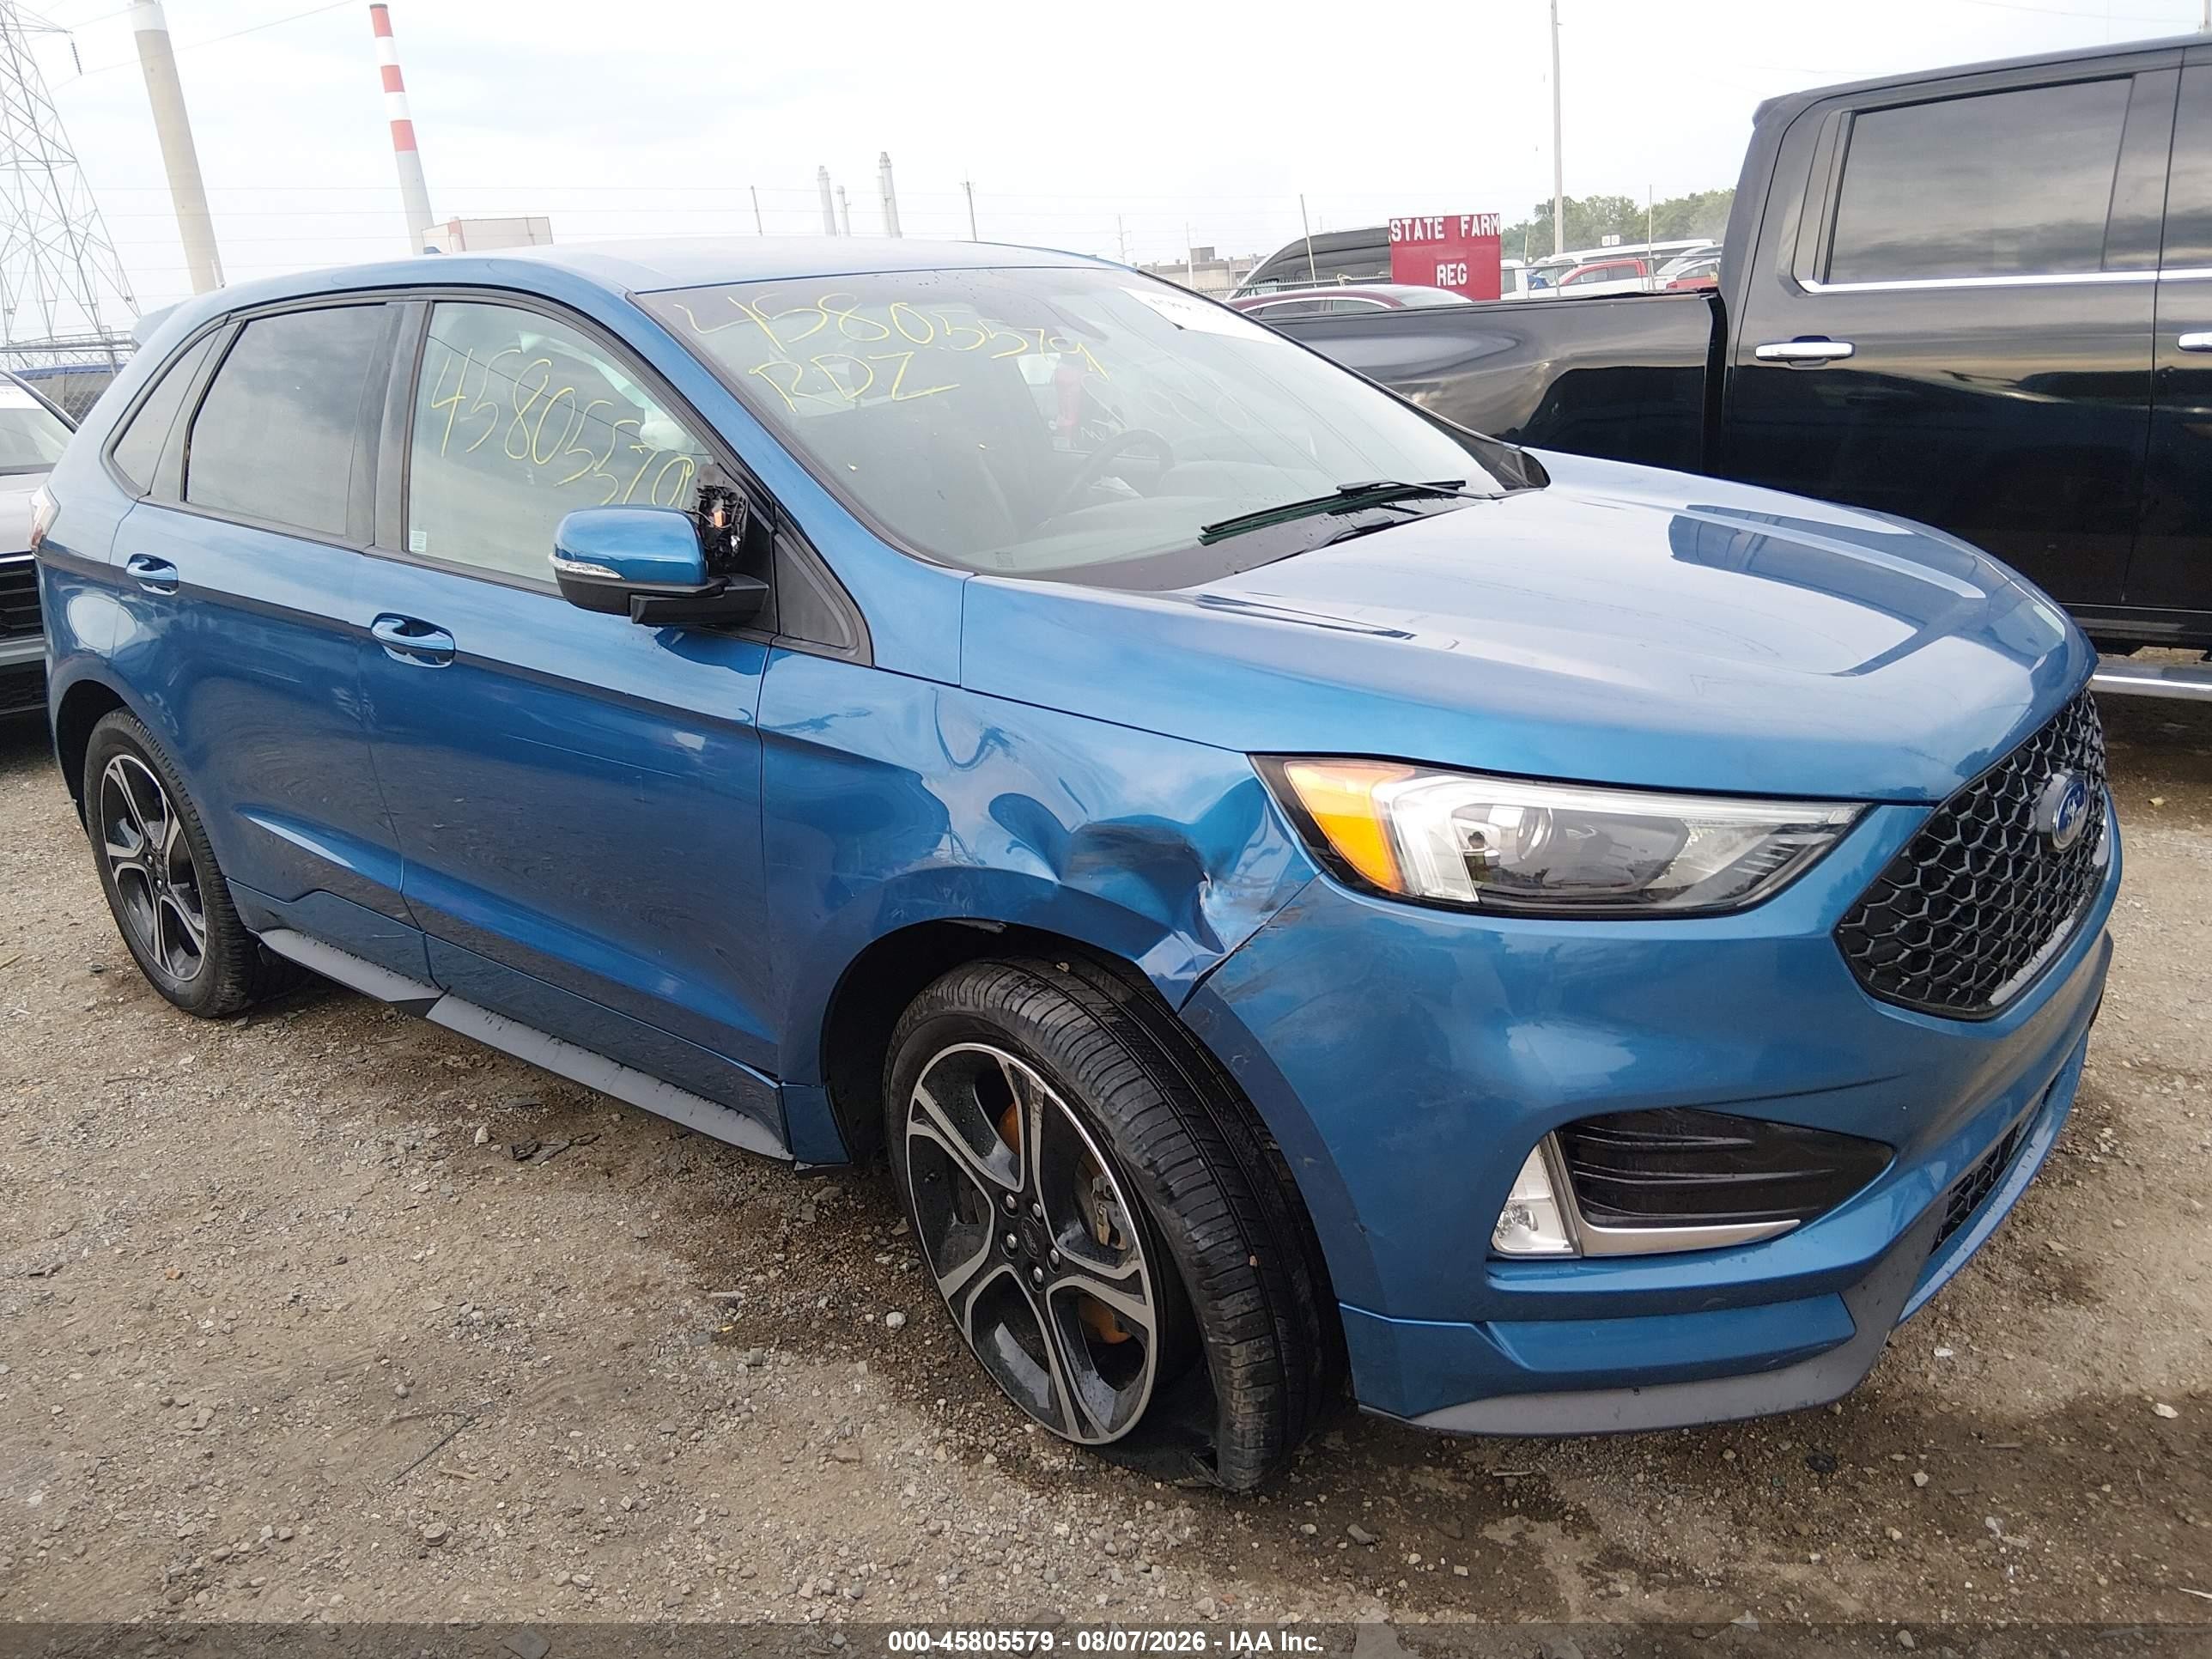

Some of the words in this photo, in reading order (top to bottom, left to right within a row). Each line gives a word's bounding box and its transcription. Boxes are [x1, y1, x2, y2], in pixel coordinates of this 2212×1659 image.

[1390, 216, 1446, 242] STATE
[1460, 214, 1501, 238] FARM
[1436, 263, 1468, 287] REG
[672, 293, 1110, 382] 45805579
[430, 347, 695, 507] 45805579
